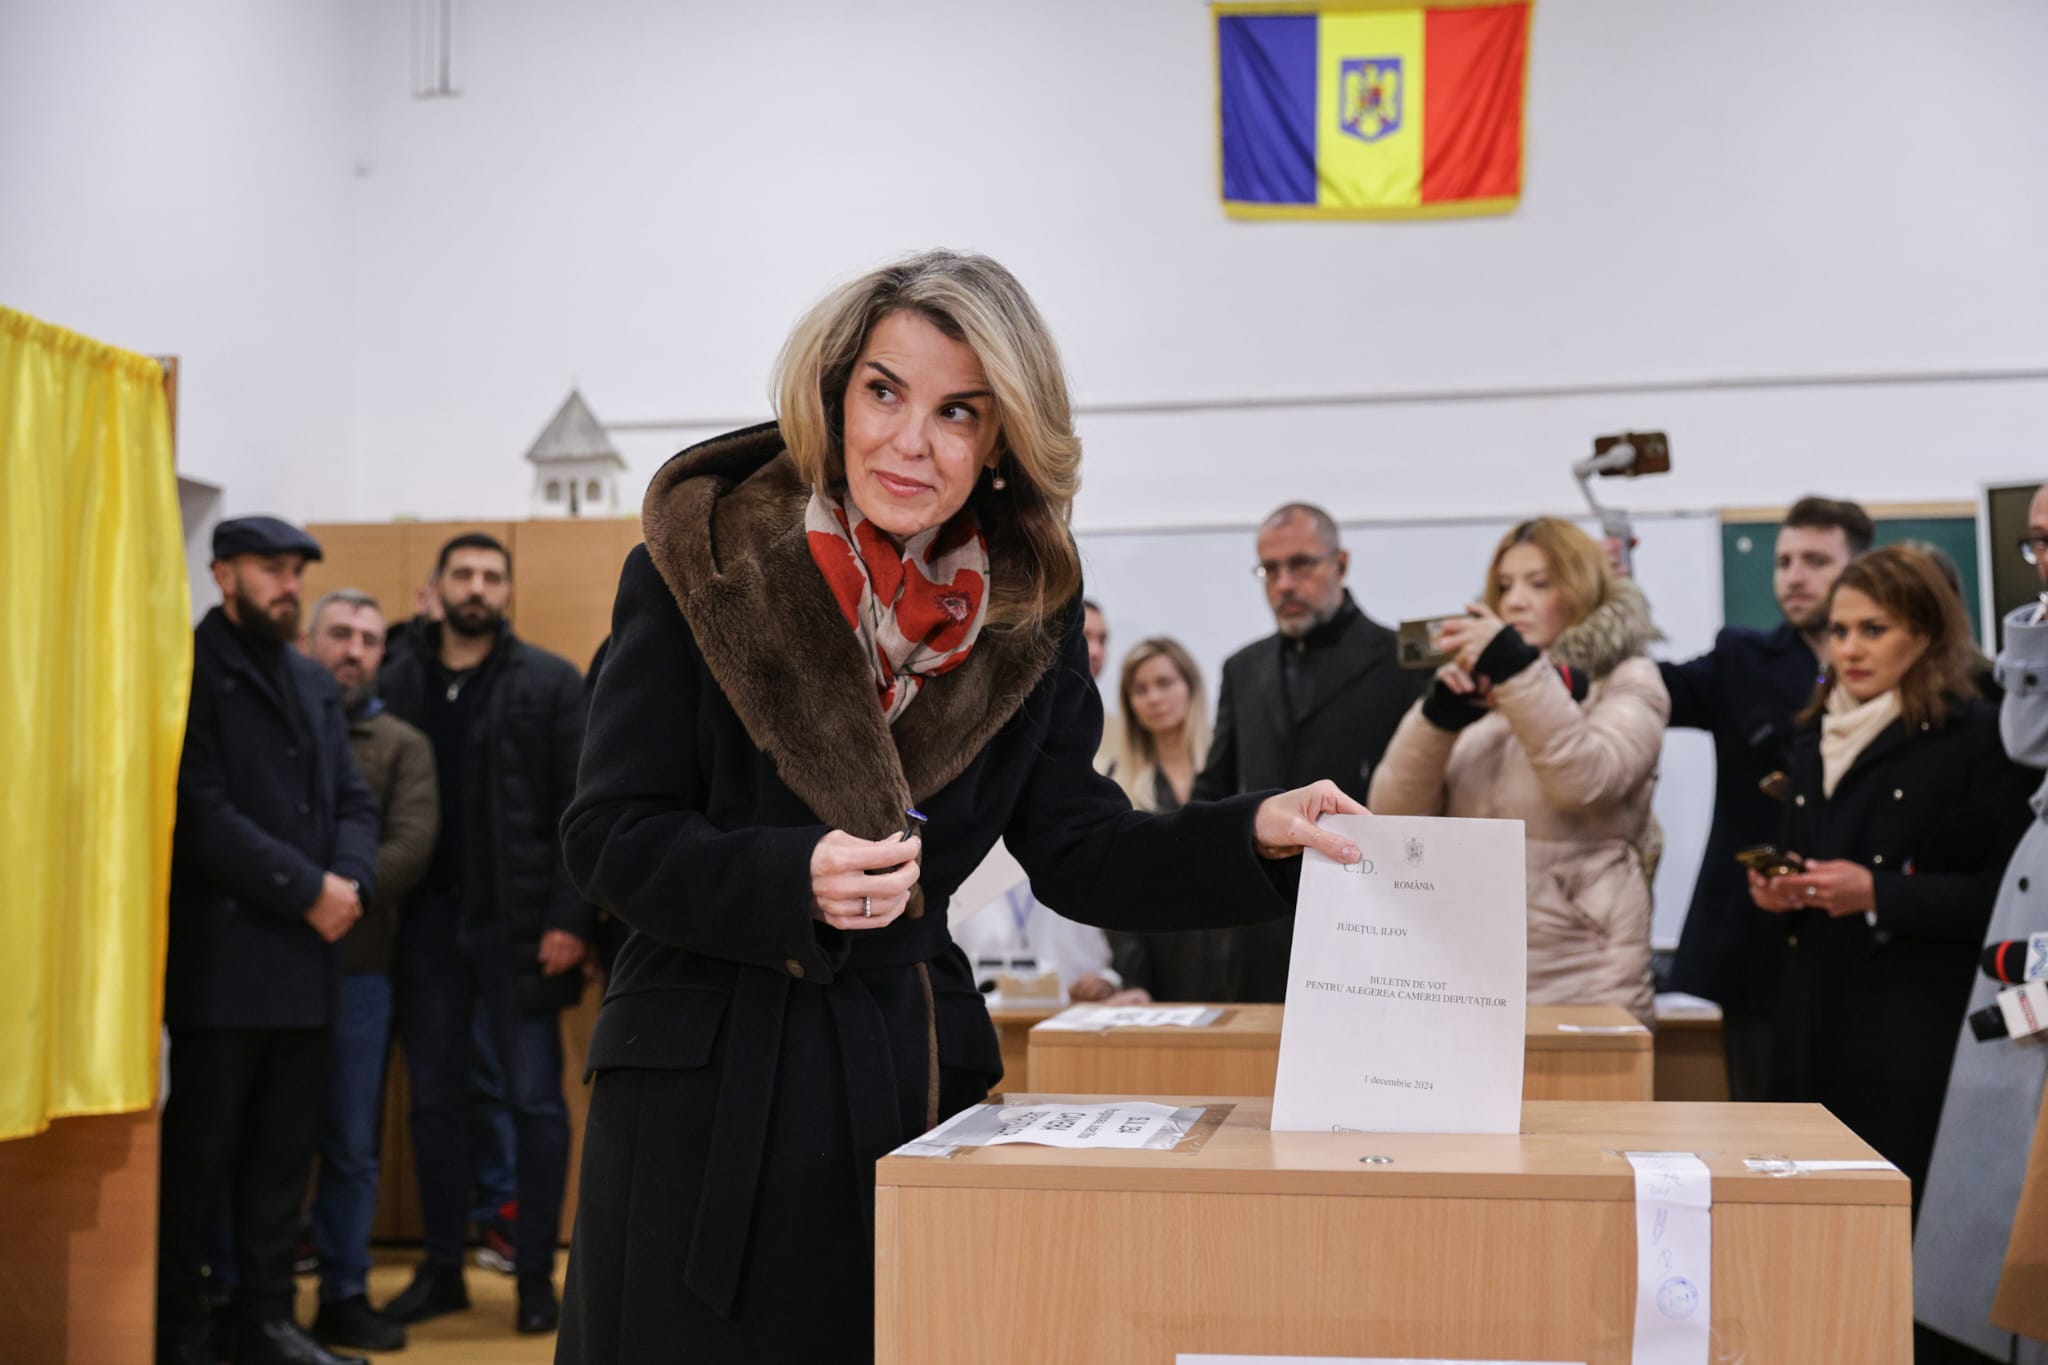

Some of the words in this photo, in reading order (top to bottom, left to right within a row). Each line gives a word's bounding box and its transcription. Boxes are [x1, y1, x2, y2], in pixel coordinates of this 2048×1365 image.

[1343, 859, 1378, 875] C.D.
[1394, 880, 1435, 891] ROMÂNIA
[1381, 927, 1409, 937] ILFOV
[1370, 976, 1411, 987] BULETIN
[1413, 980, 1425, 990] DE
[1428, 981, 1447, 991] VOT
[1305, 980, 1344, 992] PENTRU
[1345, 985, 1396, 999] ALEGEREA
[1397, 990, 1441, 1003] CAMEREI
[1371, 1075, 1413, 1088] decembrie
[1414, 1080, 1434, 1090] 2024
